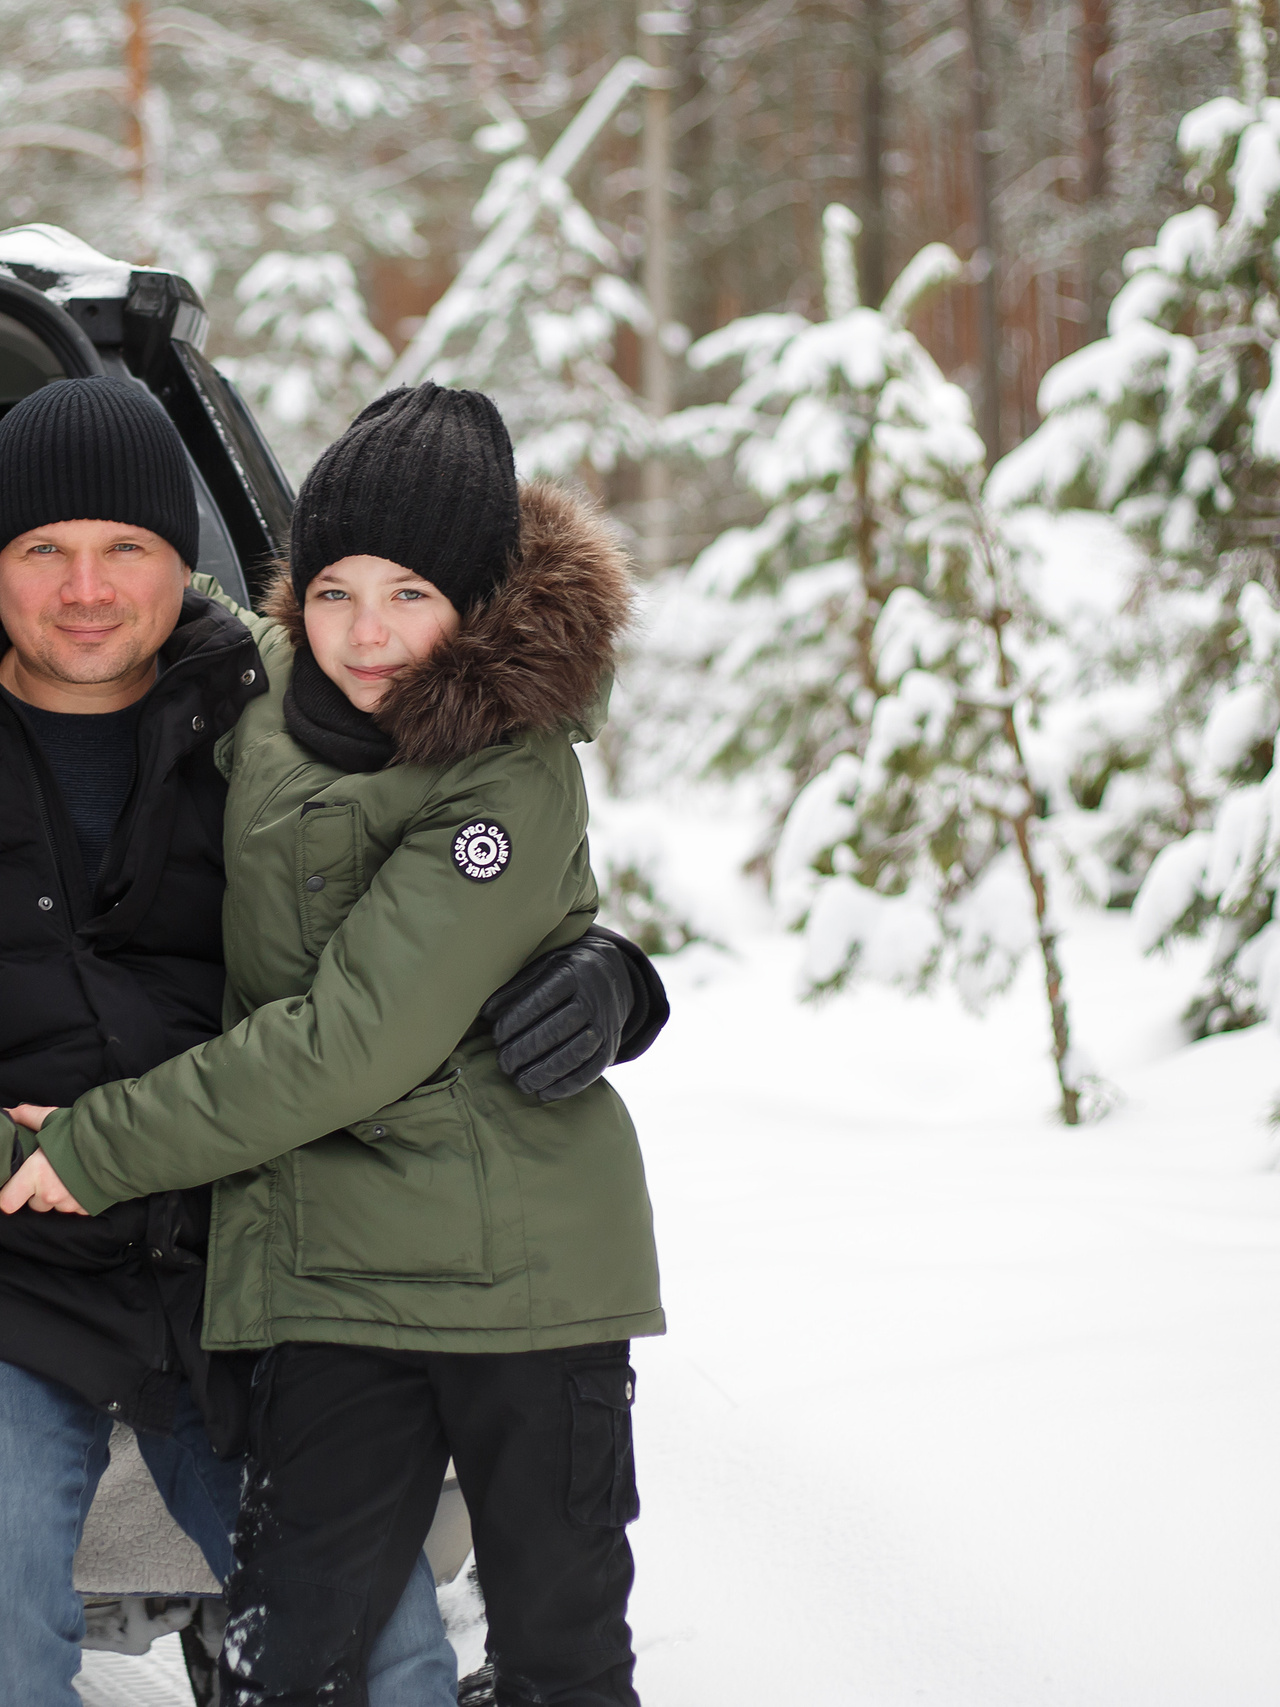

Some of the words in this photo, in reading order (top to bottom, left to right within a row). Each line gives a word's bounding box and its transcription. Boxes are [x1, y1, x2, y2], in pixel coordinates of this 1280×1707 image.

[461, 823, 486, 839] PRO
[454, 836, 469, 866] LOSE
[487, 826, 509, 864] GAMER
[465, 862, 501, 878] NEVER
